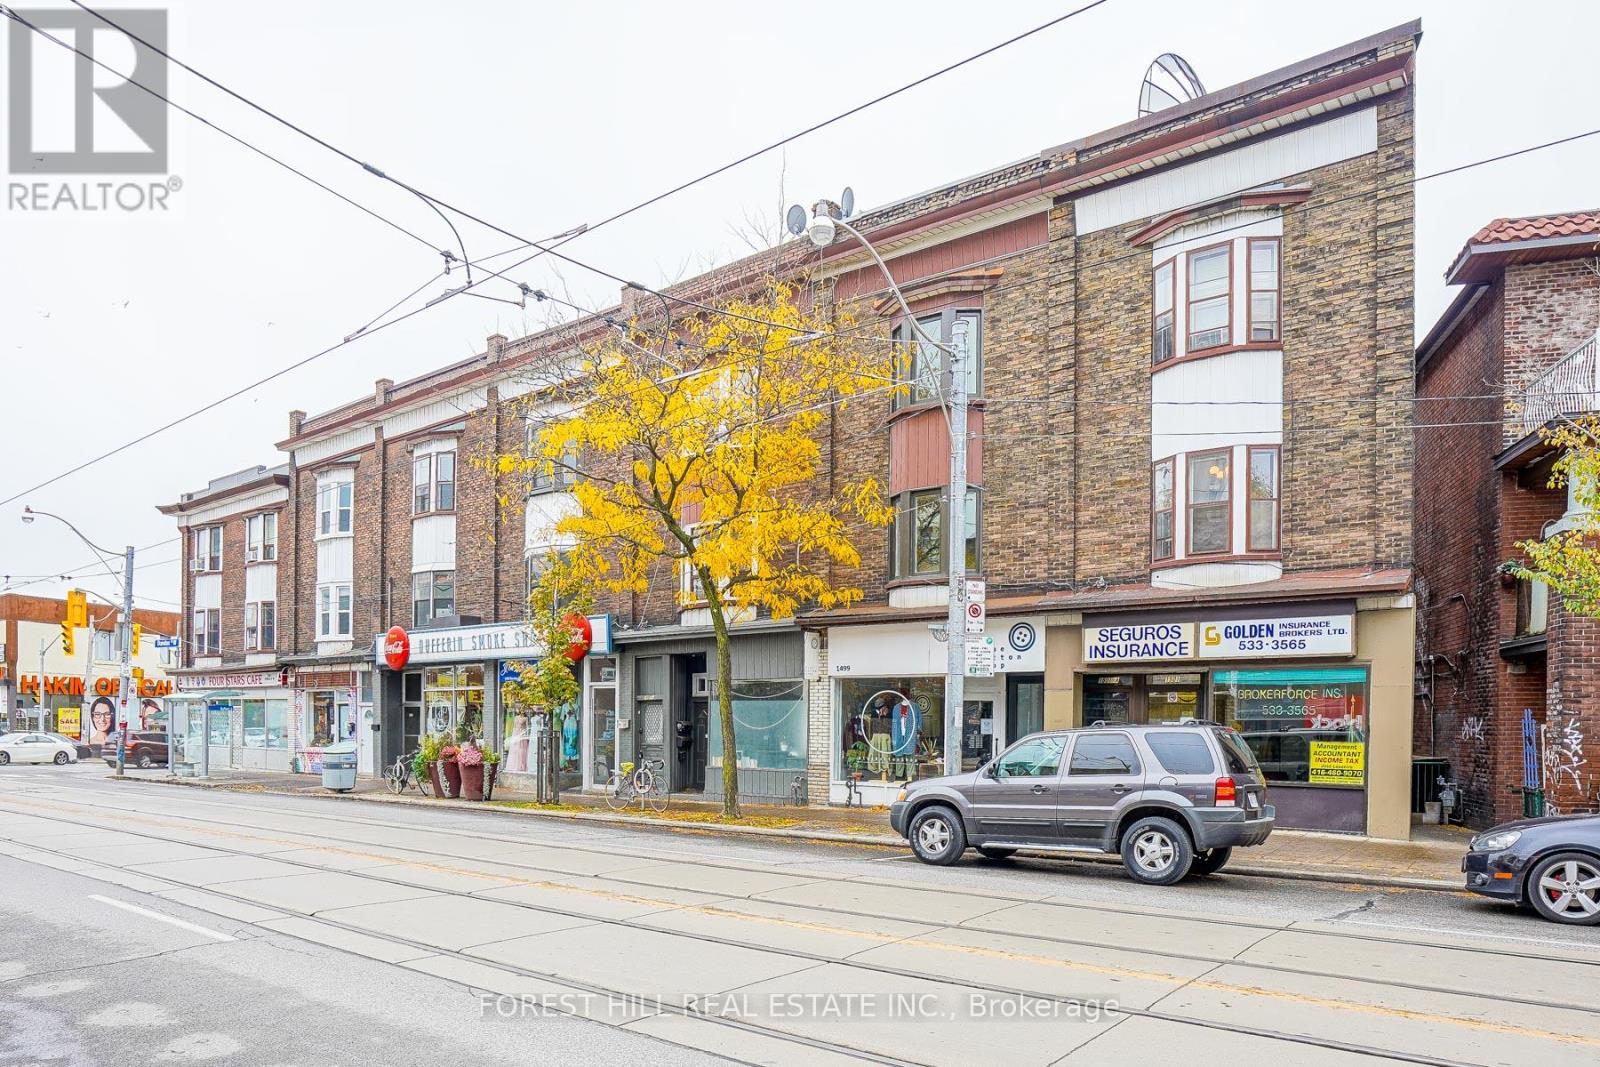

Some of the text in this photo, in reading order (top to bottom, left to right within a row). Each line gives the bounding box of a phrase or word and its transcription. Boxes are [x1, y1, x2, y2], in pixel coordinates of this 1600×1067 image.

[1224, 624, 1275, 639] GOLDEN
[1279, 621, 1331, 630] INSURANCE
[1098, 625, 1182, 642] SEGUROS
[1279, 628, 1348, 637] BROKERS LTD.
[419, 635, 463, 653] DUFFERIN
[472, 633, 505, 650] SMOKE
[1089, 641, 1189, 659] INSURANCE
[209, 674, 225, 687] FOUR
[226, 674, 246, 686] STARS
[246, 674, 263, 685] CAFE
[1237, 688, 1344, 700] BROKERFORCE INS.
[1262, 705, 1317, 715] 533-3565
[1316, 743, 1358, 751] Management
